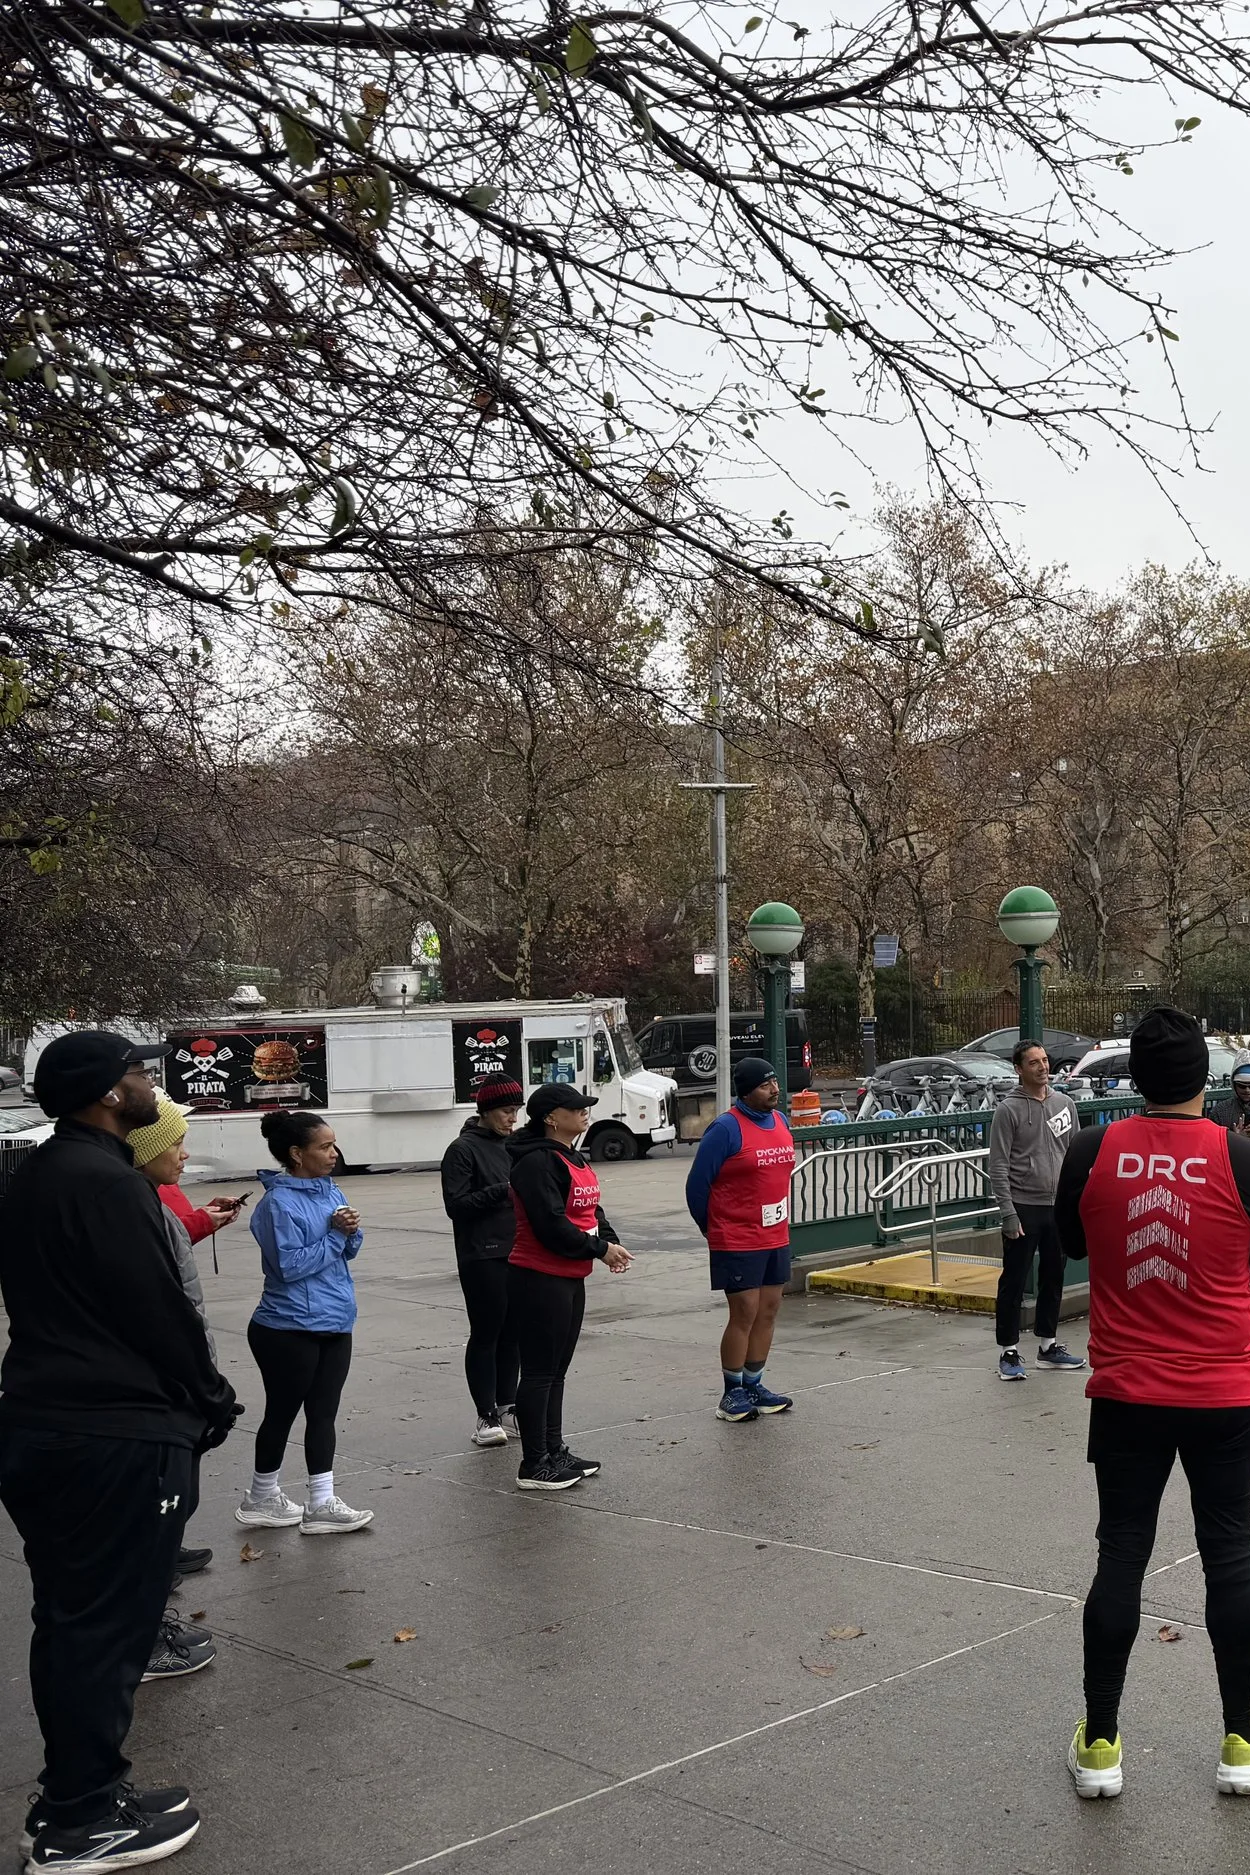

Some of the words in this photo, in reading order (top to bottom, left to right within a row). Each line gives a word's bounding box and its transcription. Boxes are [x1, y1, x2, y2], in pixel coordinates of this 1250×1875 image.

[474, 1062, 504, 1073] PIRATA
[699, 1052, 714, 1071] 30
[187, 1081, 226, 1096] PIRATA
[1055, 1113, 1070, 1131] 22
[757, 1157, 777, 1167] RUN
[1117, 1153, 1207, 1184] DRC
[573, 1197, 592, 1207] RUN
[775, 1205, 783, 1220] 5
